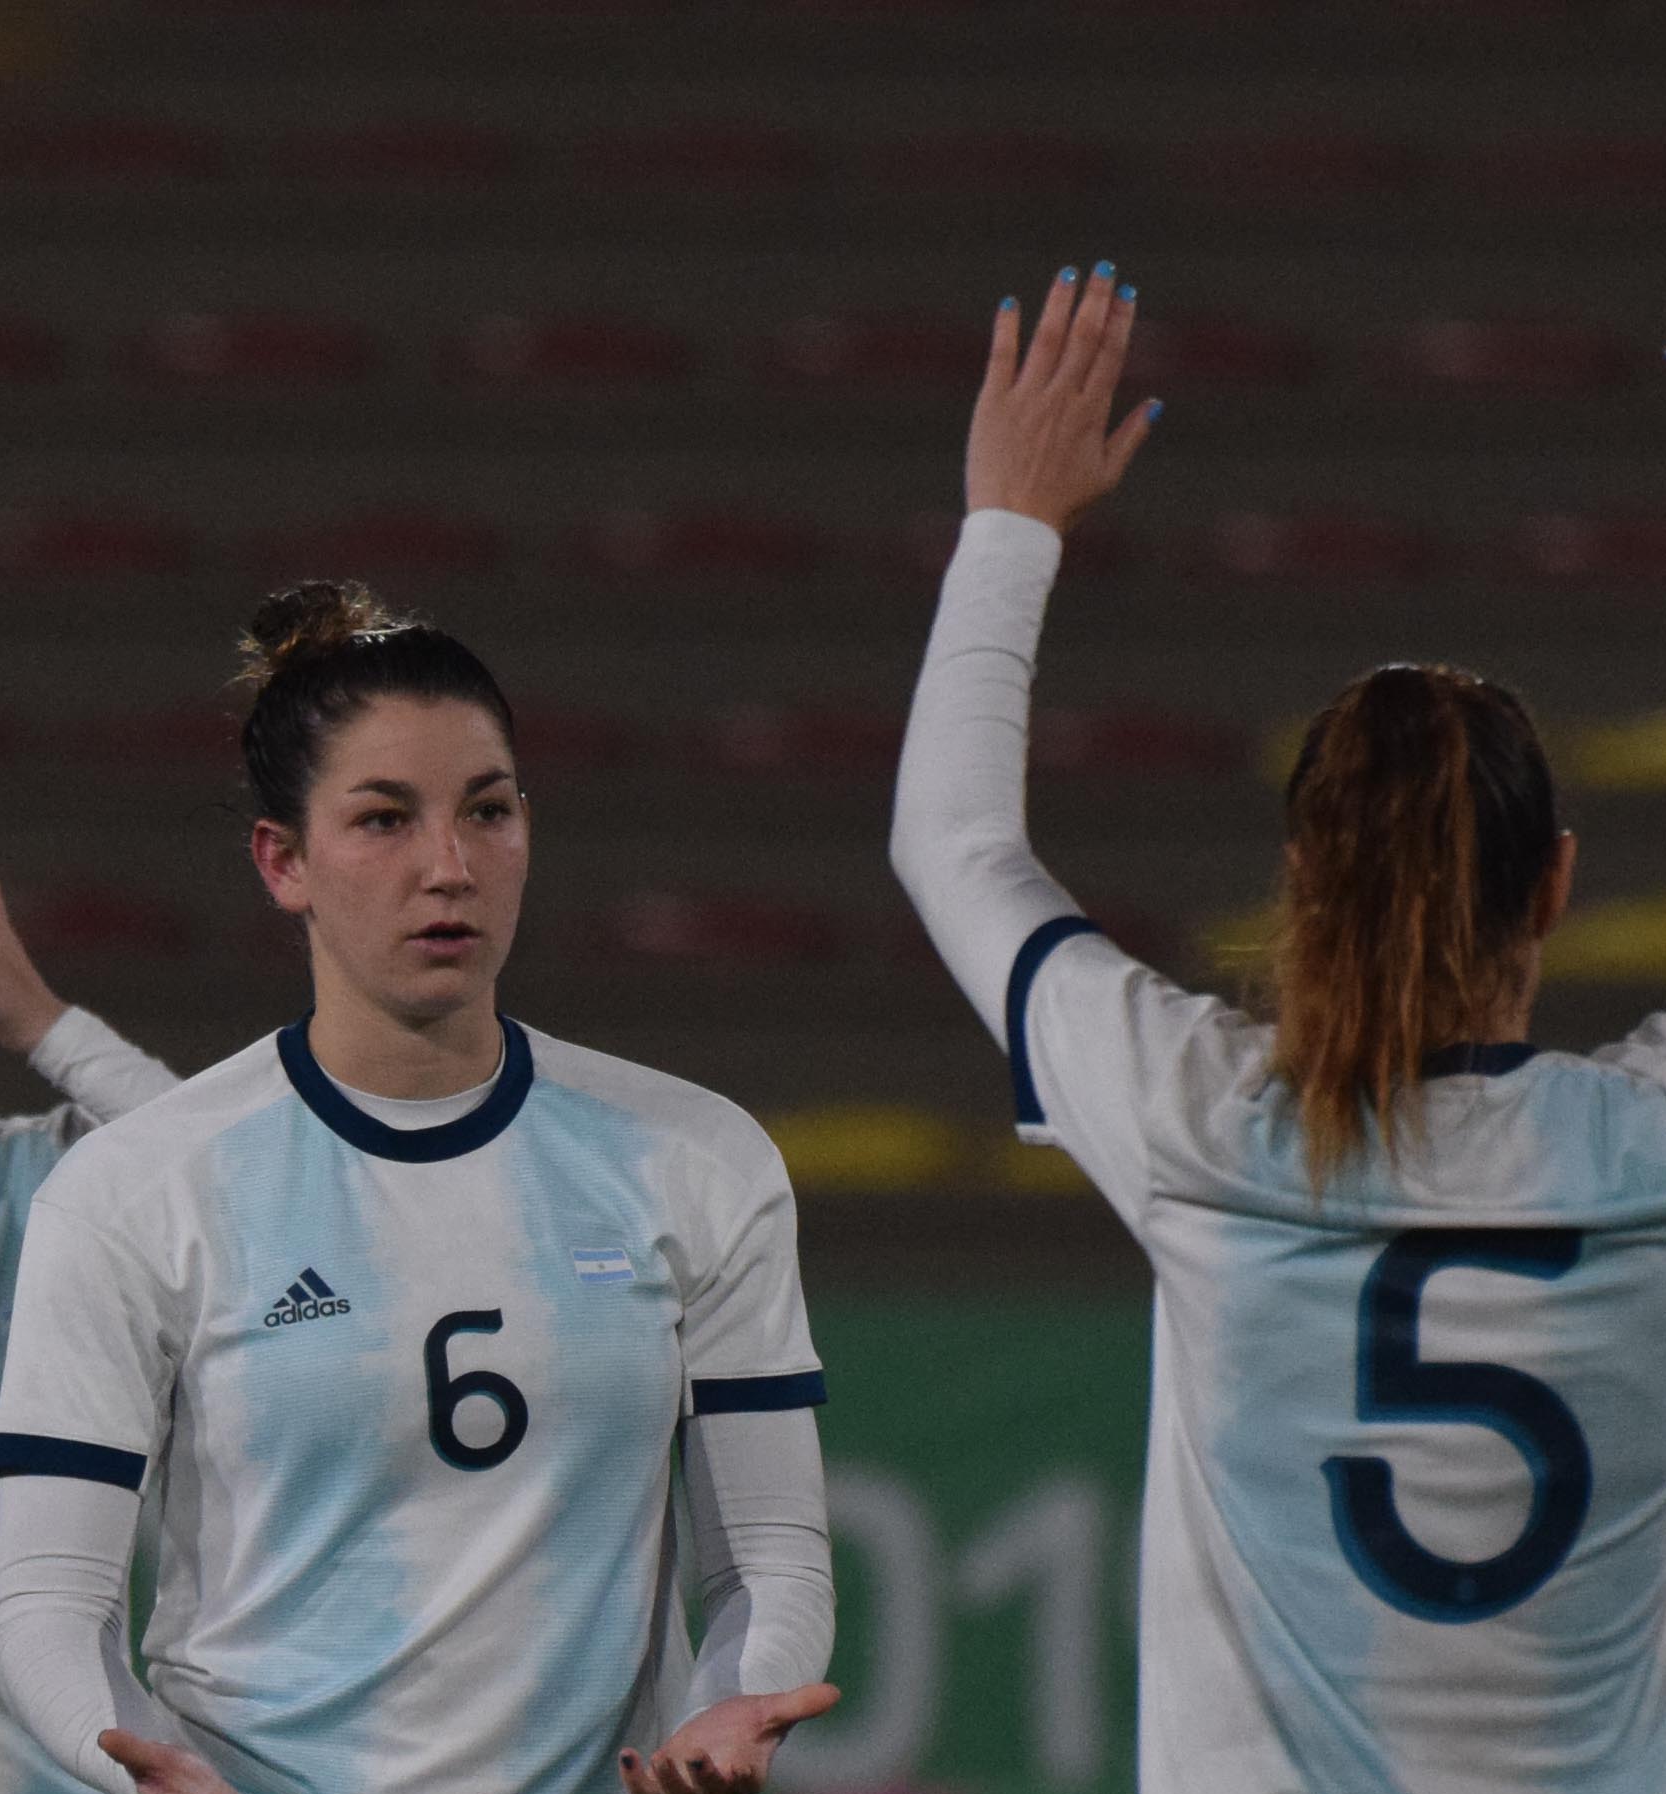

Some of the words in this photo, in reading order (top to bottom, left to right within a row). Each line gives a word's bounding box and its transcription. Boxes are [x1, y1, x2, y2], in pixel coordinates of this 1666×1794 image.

[263, 1296, 351, 1328] adidas
[425, 1308, 528, 1471] 6
[1320, 1226, 1593, 1624] 5
